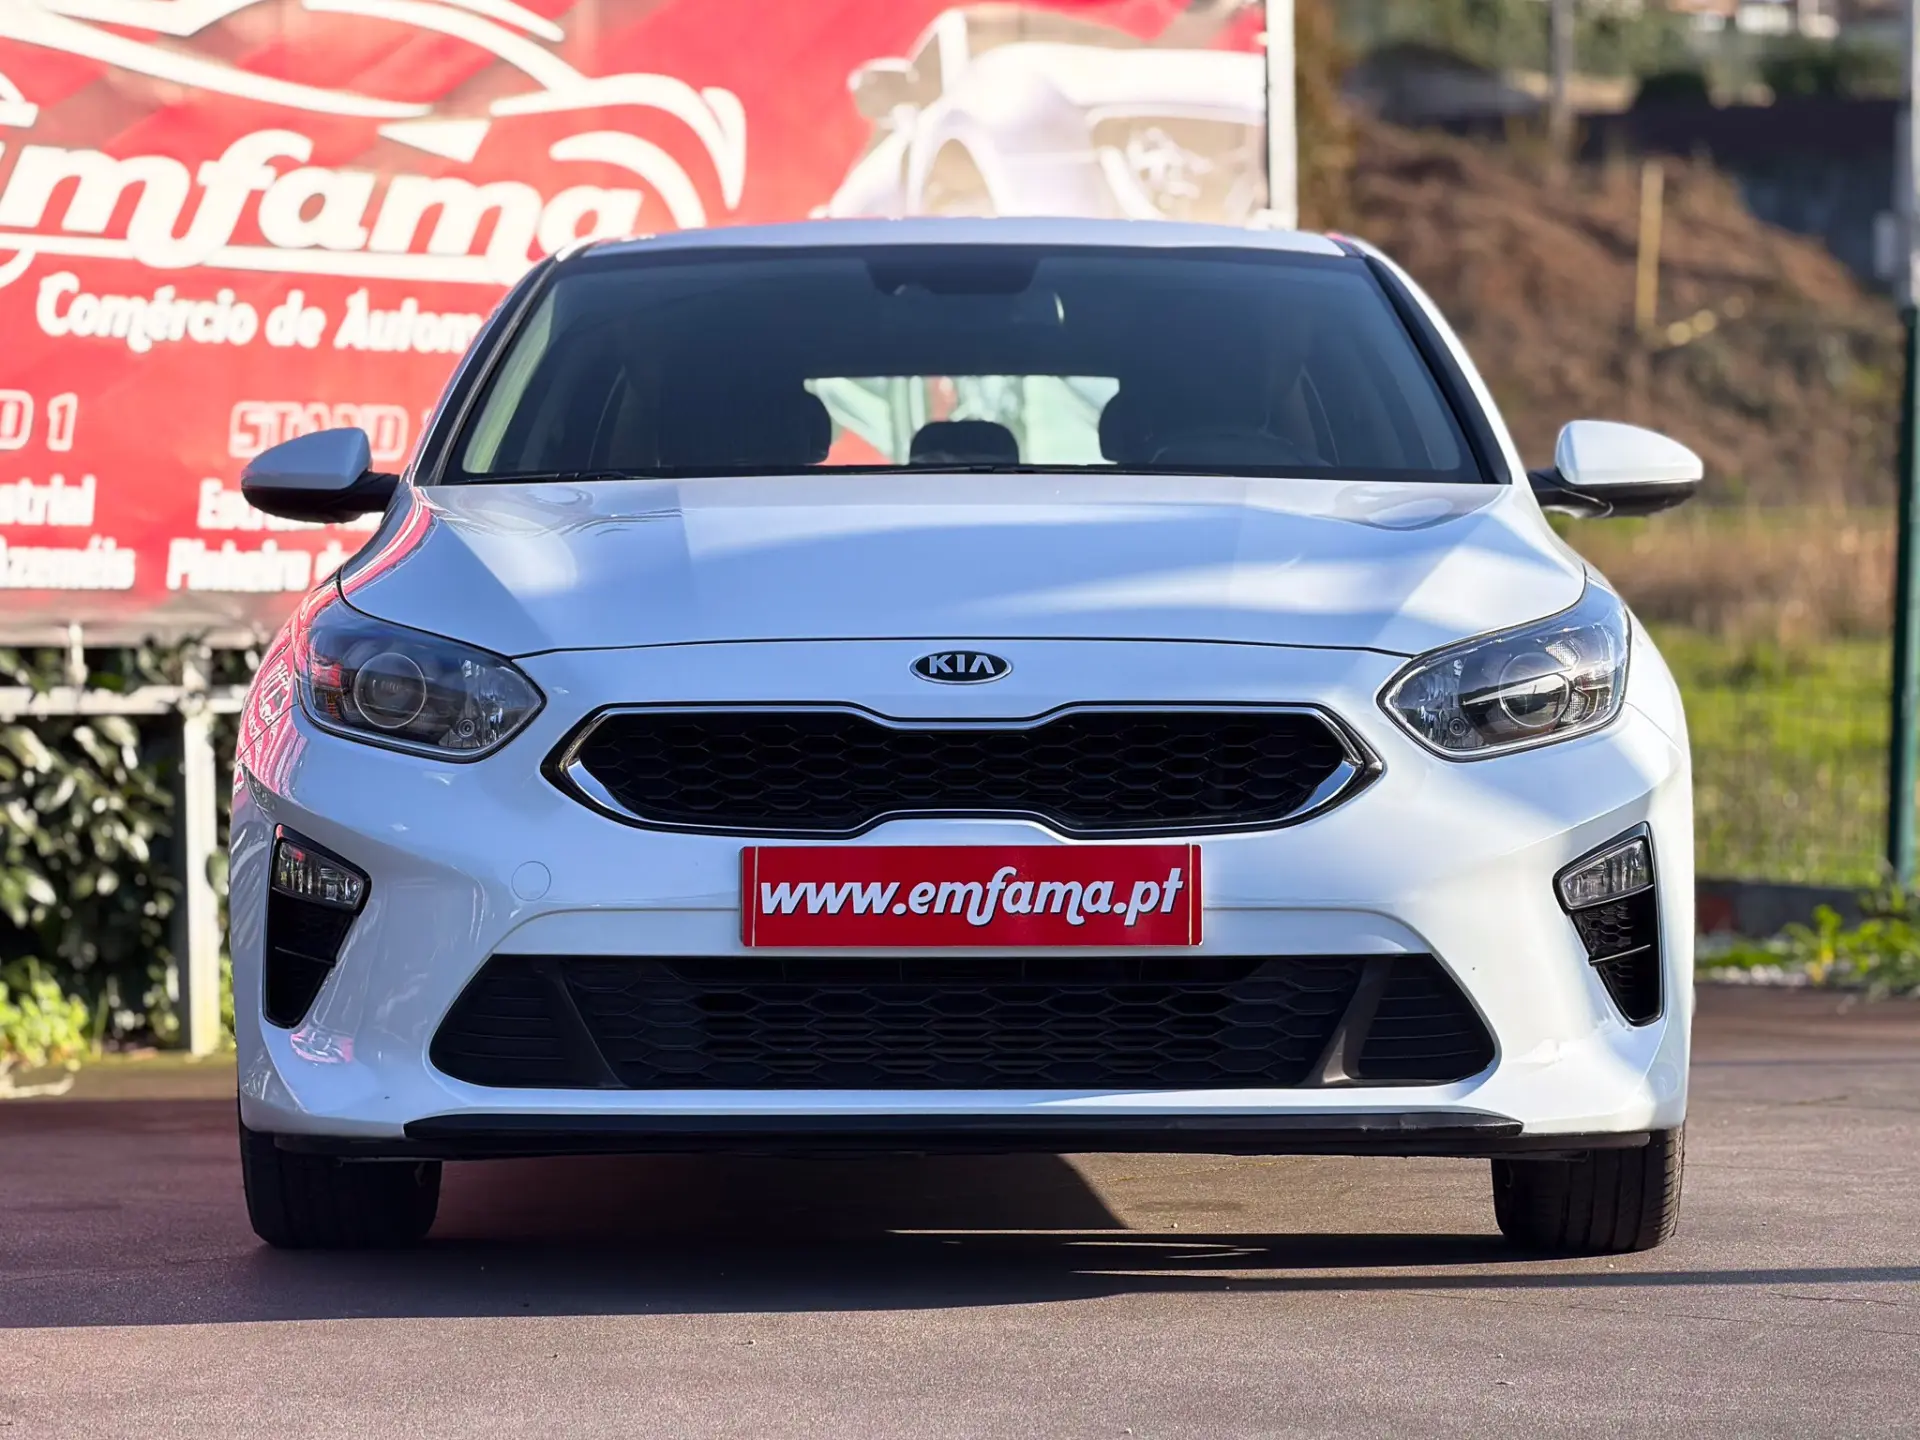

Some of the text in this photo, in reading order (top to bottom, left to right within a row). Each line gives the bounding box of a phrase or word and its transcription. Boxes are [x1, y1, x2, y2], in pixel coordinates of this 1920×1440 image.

[0, 130, 643, 280] mfama
[37, 272, 259, 353] Comércio
[265, 290, 326, 349] de
[46, 392, 79, 452] 1
[928, 653, 996, 675] KIA
[760, 866, 1184, 927] www.emfama.pt
